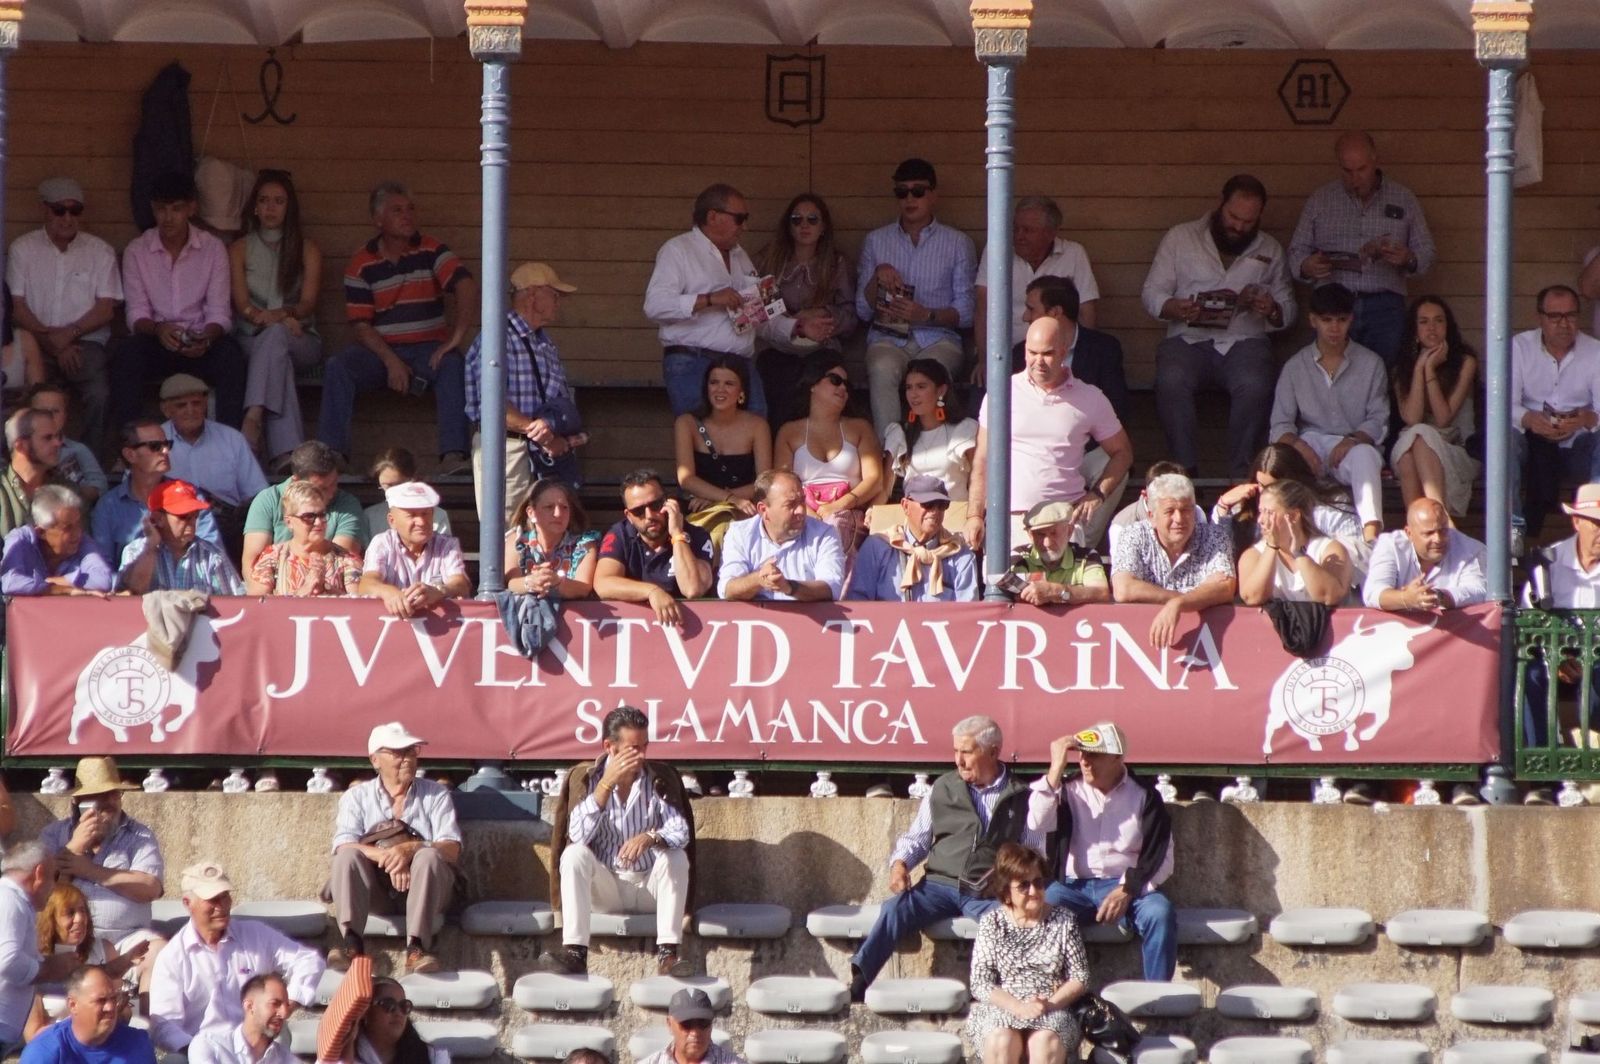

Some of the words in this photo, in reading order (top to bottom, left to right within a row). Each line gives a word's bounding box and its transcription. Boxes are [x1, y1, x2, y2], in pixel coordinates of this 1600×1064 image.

[600, 533, 617, 553] 2
[702, 540, 714, 558] 4
[575, 697, 929, 745] SLAMANCA
